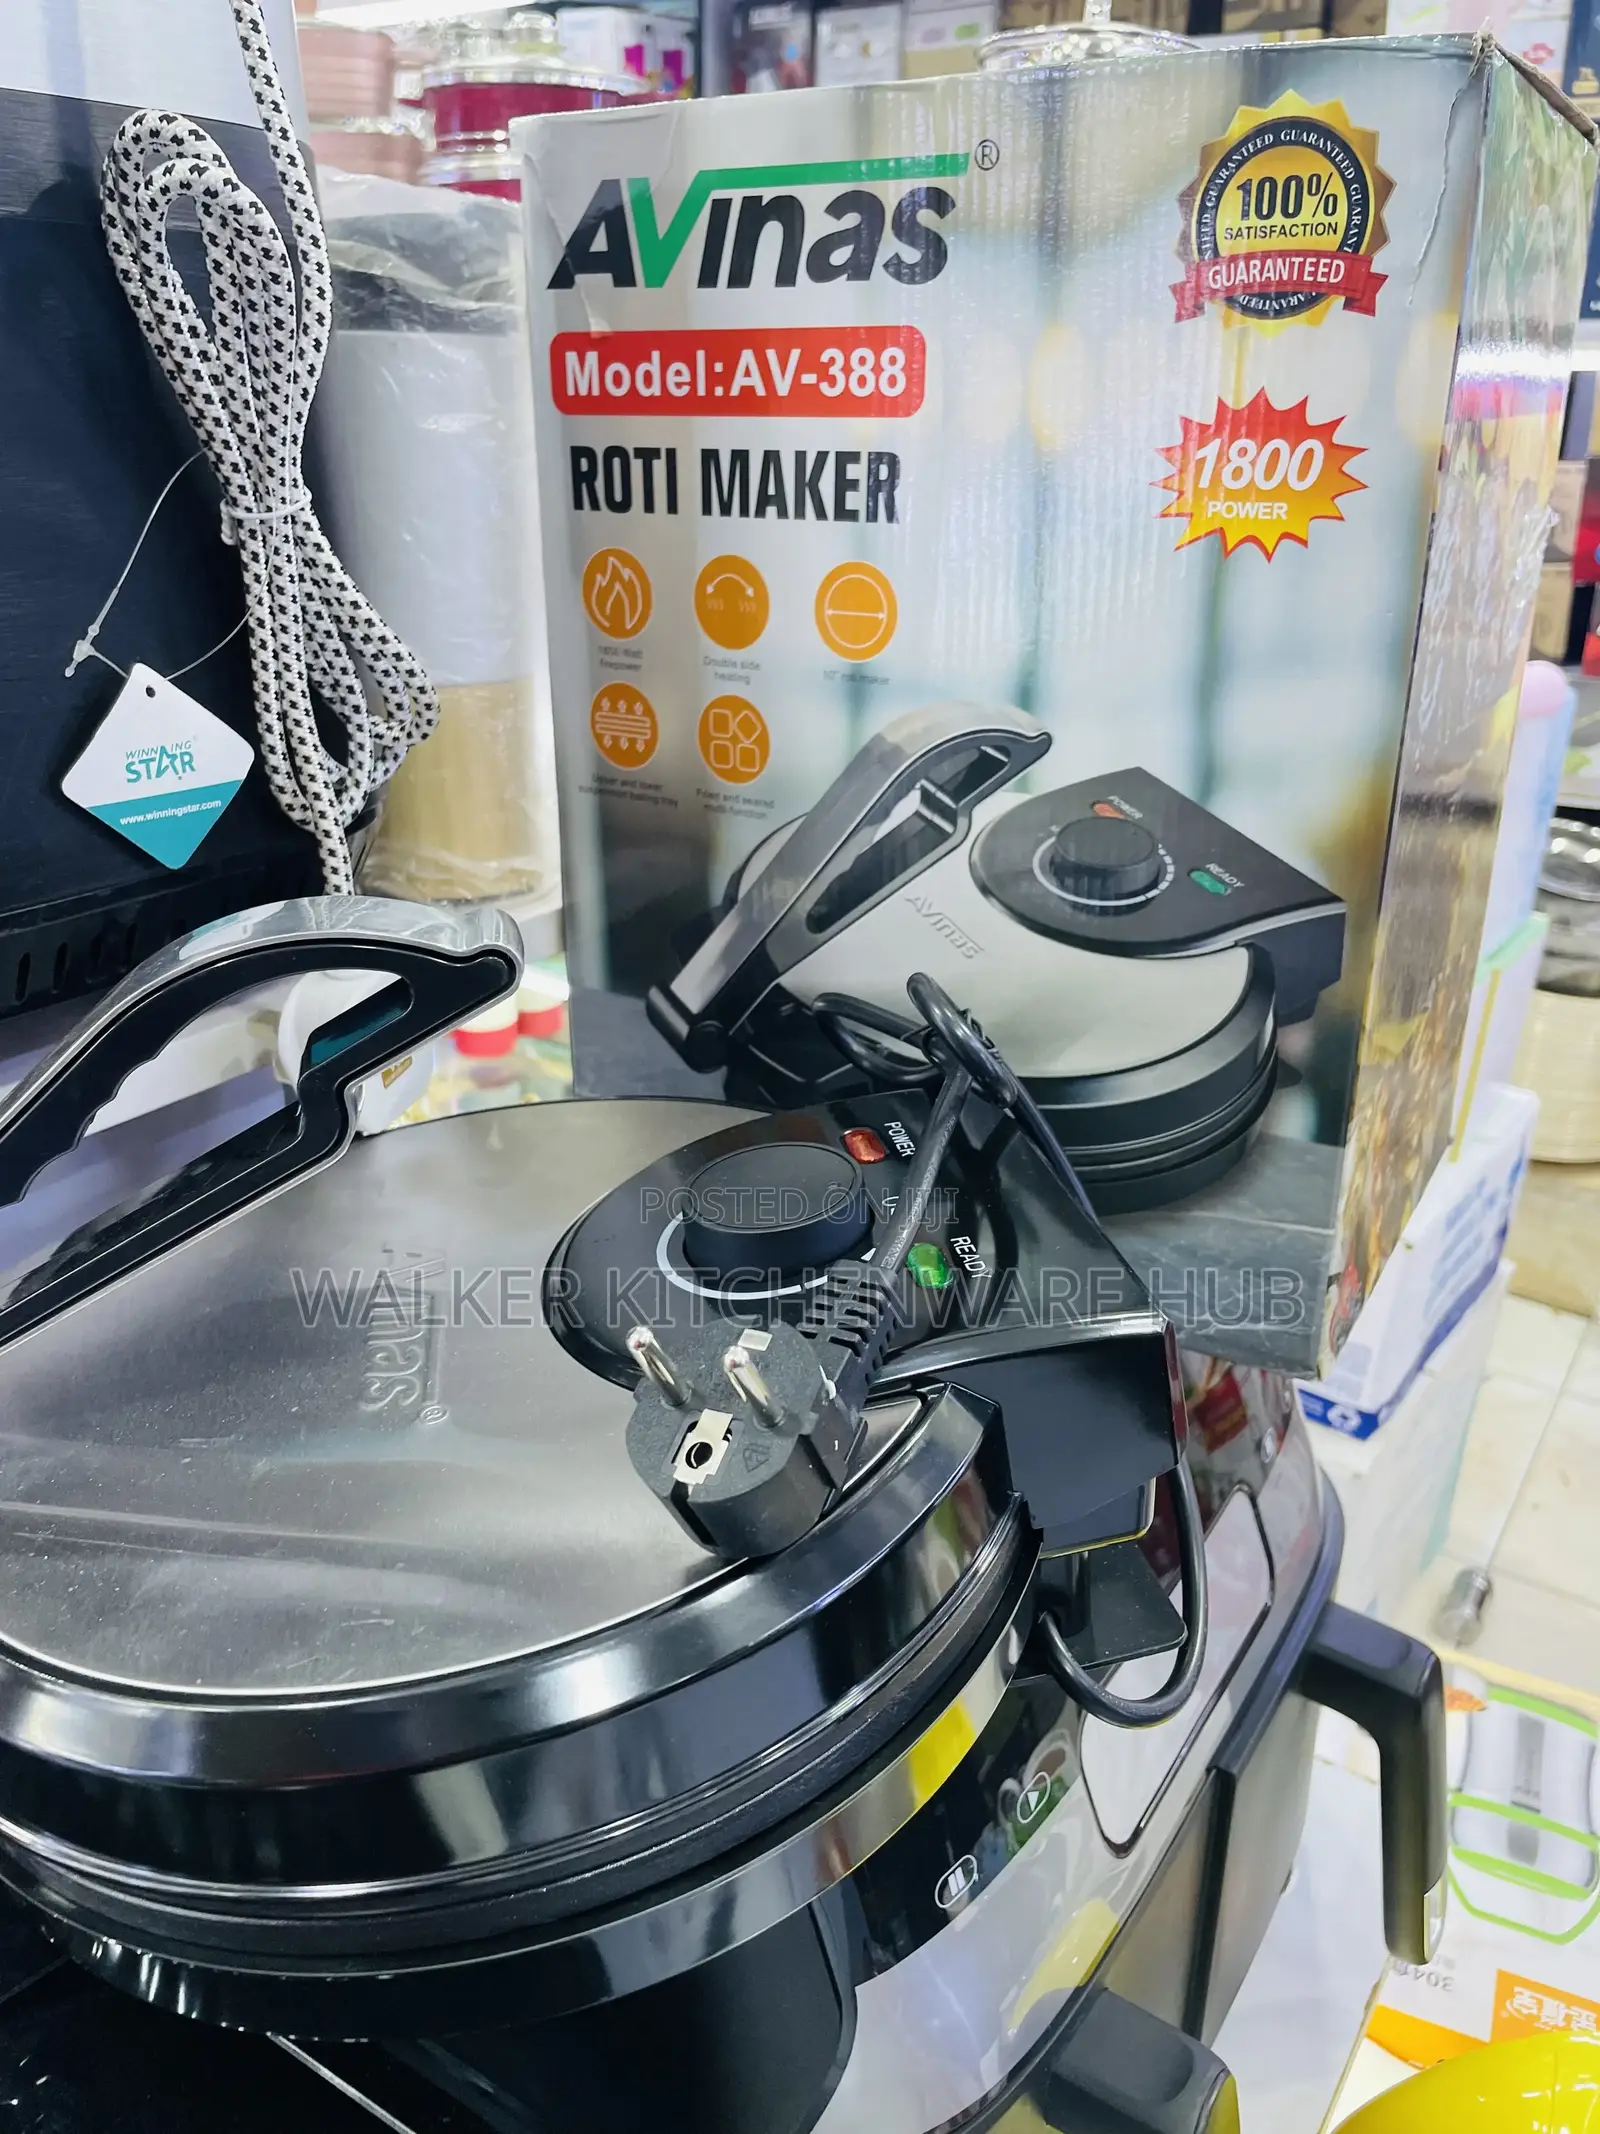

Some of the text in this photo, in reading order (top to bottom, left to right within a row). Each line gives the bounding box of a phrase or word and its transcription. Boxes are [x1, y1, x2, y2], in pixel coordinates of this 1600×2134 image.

[1205, 133, 1274, 207] GUARANTEED
[1280, 128, 1356, 180] GUARANTEED
[1236, 171, 1339, 221] 100%
[1223, 221, 1339, 241] SATISFACTION
[1343, 184, 1363, 253] GUARANT
[1208, 256, 1345, 290] GUARANTEED
[564, 347, 907, 398] Model:AV-388
[1194, 438, 1325, 491] 1800
[569, 445, 902, 524] ROTI MAKER
[1207, 500, 1288, 520] POWER
[125, 740, 192, 761] WINNING
[125, 745, 196, 784] STAR
[120, 800, 222, 826] www.winningstar.com
[1106, 795, 1144, 821] POWER
[1205, 862, 1245, 890] READY
[884, 1121, 916, 1158] POWER
[950, 1236, 993, 1279] READY
